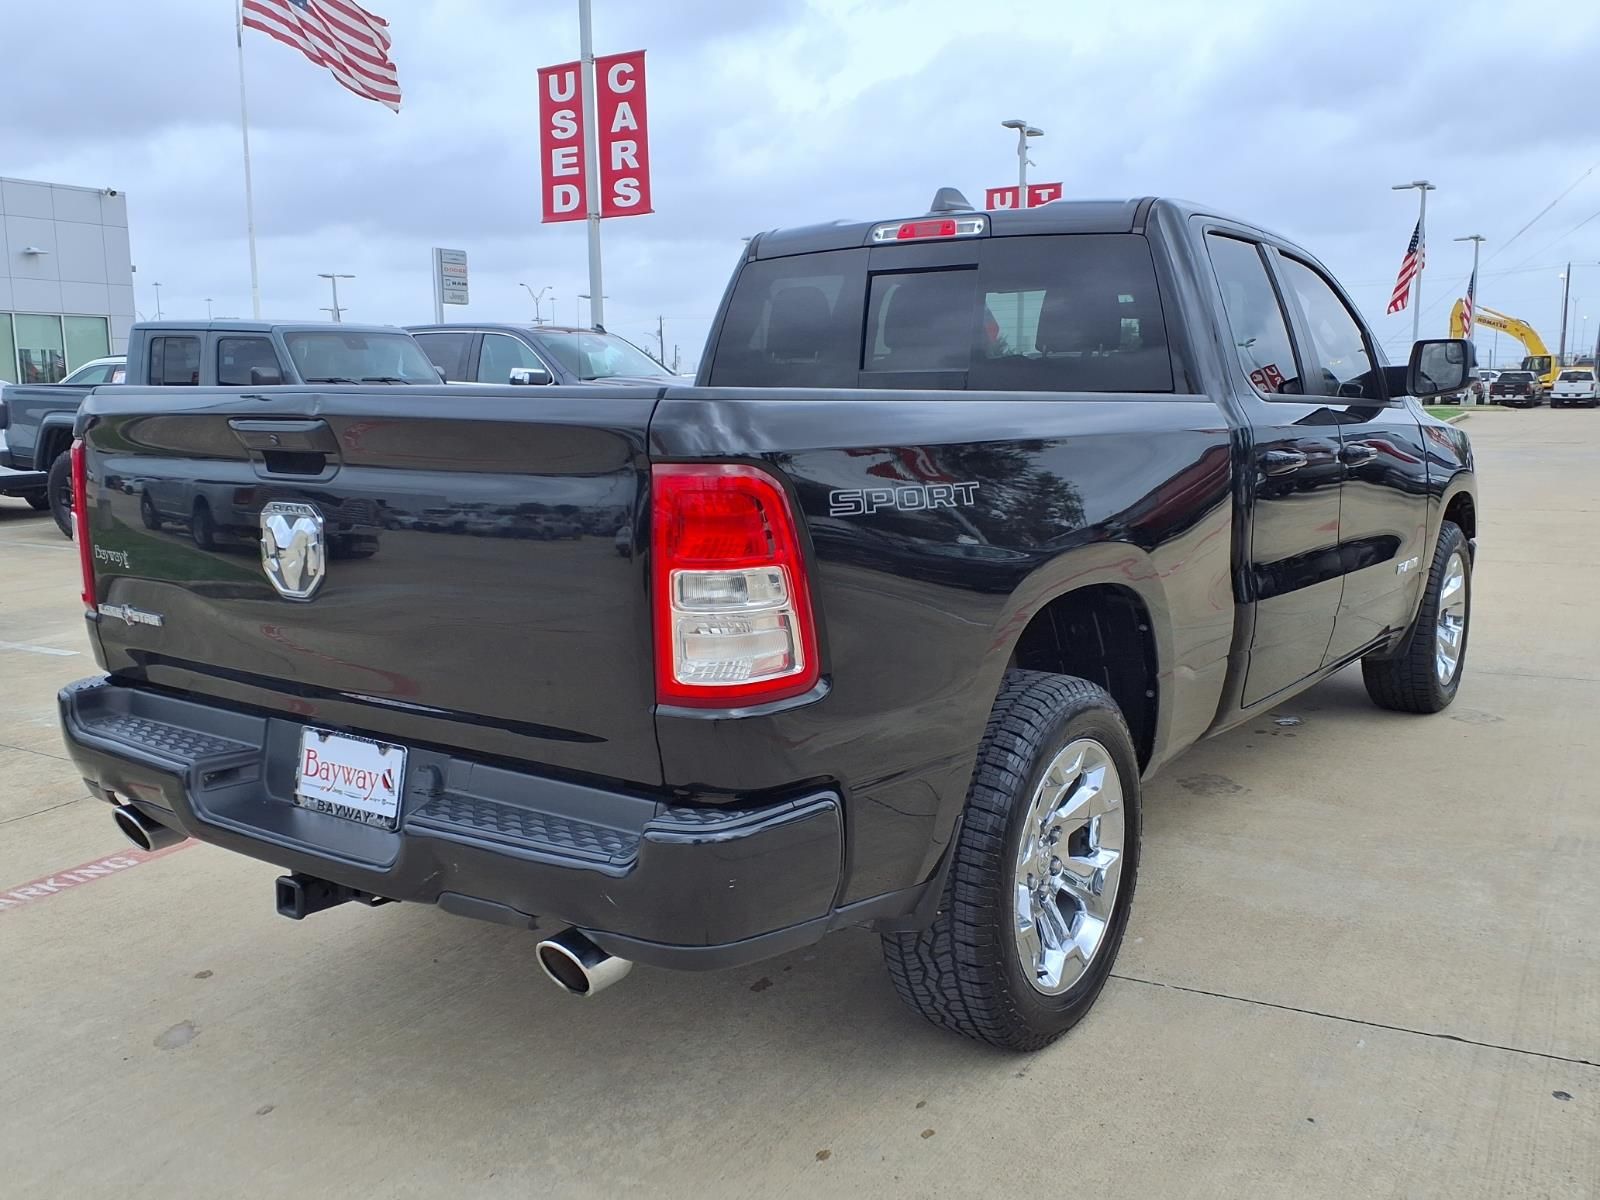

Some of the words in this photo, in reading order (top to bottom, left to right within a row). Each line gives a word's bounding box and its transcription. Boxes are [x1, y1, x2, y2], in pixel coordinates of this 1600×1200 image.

[548, 71, 580, 214] USED
[607, 62, 641, 208] CARS
[1477, 317, 1508, 329] KOMATSU
[272, 504, 308, 513] RAM
[829, 481, 980, 517] SPORT
[94, 544, 124, 567] Bayway
[303, 748, 379, 801] Bayway
[316, 800, 373, 823] BAYWAY
